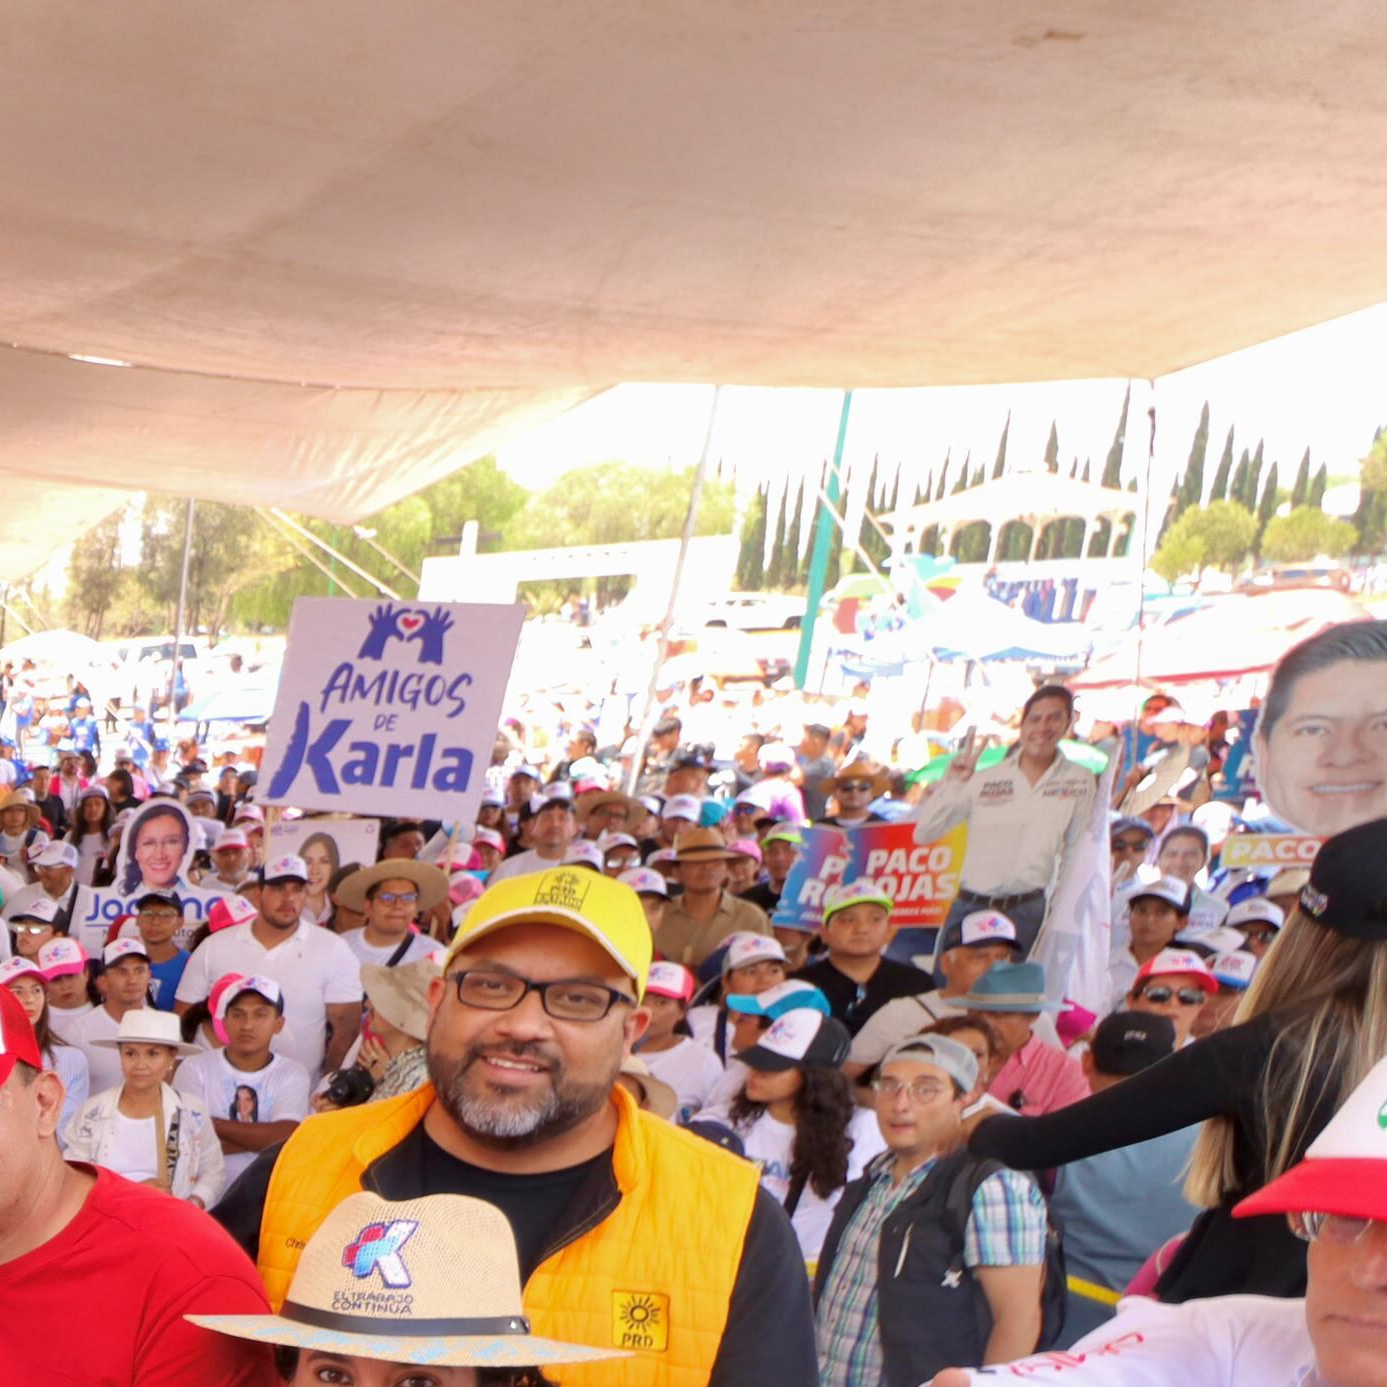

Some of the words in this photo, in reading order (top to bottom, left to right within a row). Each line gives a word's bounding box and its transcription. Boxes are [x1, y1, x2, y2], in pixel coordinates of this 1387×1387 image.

[321, 662, 472, 718] AMIGOS
[374, 714, 398, 731] DE
[265, 700, 474, 799] Karla
[1230, 840, 1322, 860] PACO
[866, 846, 952, 875] PACO
[334, 1291, 348, 1301] EL
[622, 1333, 653, 1347] PRD
